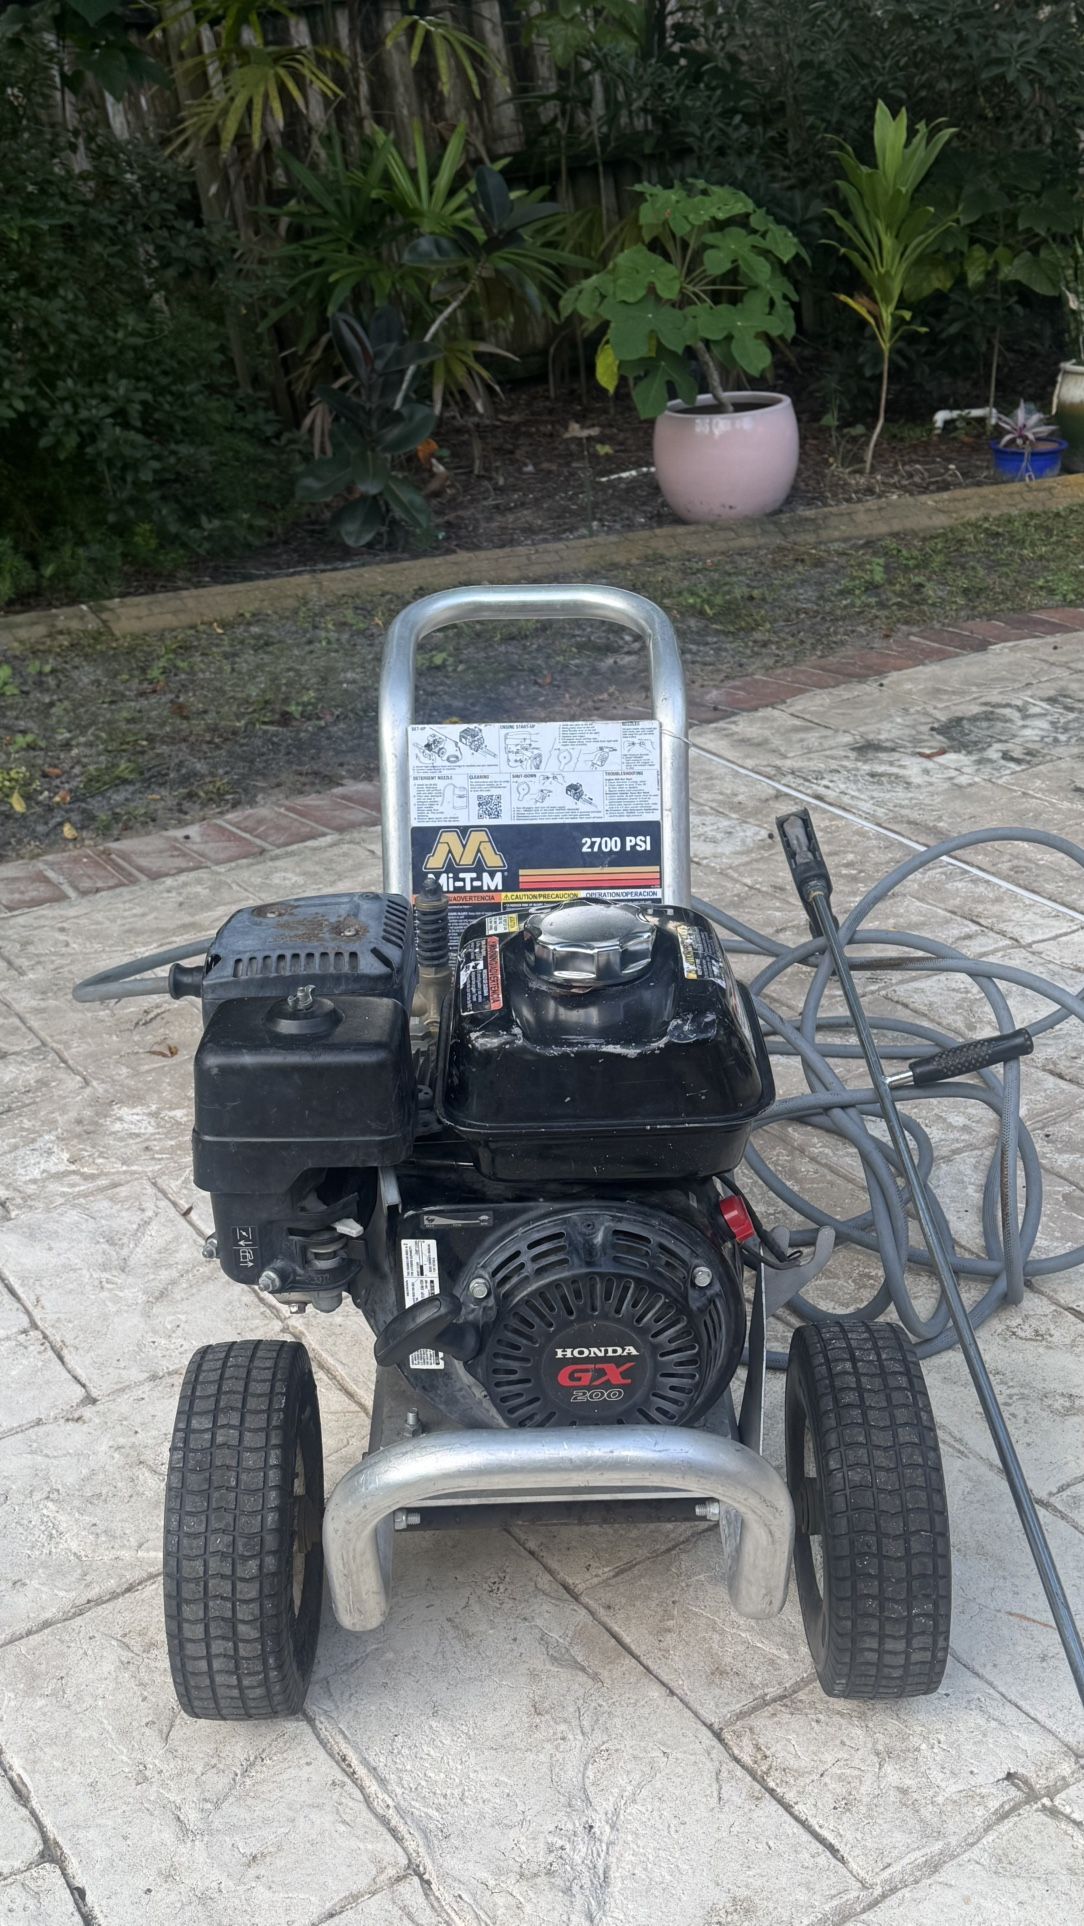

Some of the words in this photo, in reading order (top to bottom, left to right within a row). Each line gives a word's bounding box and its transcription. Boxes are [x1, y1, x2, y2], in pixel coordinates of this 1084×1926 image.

[581, 837, 621, 852] 2700
[625, 835, 651, 851] PSI
[555, 1346, 640, 1358] HONDA
[557, 1362, 636, 1388] GX
[570, 1388, 624, 1402] 200
